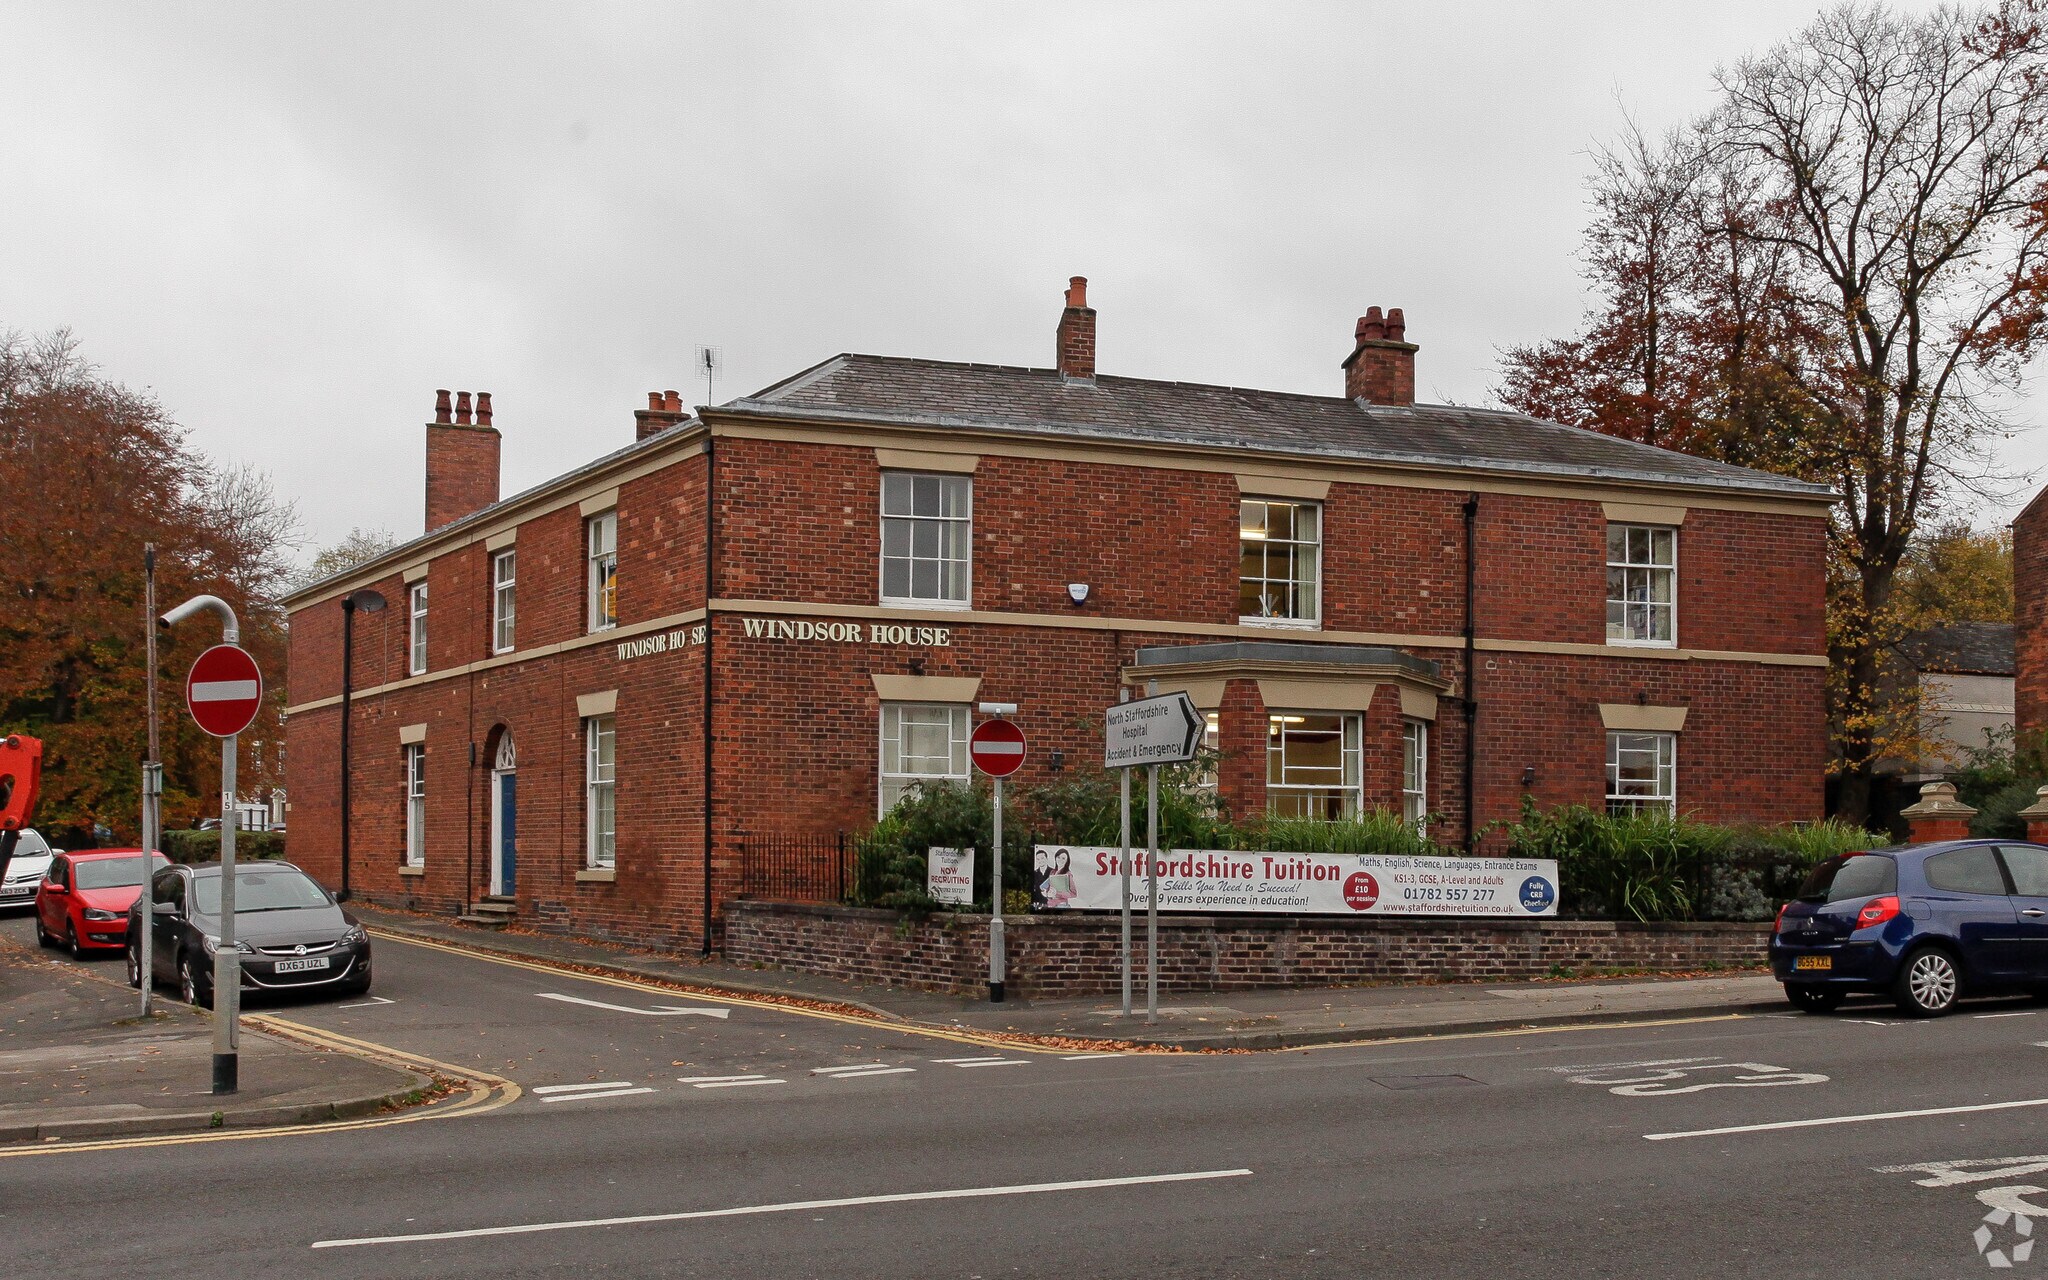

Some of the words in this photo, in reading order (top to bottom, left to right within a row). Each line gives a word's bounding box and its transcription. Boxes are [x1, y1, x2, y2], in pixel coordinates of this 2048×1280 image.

[743, 619, 862, 642] WINDSOR
[870, 624, 950, 647] HOUSE
[617, 634, 667, 660] WINDSOR
[1107, 713, 1124, 727] North
[1125, 704, 1169, 722] Staffordshire
[1122, 724, 1148, 739] Hospital
[1107, 746, 1132, 761] Accident
[1132, 745, 1137, 757] &
[1138, 743, 1182, 757] Emergency
[1262, 857, 1340, 881] Tuition
[1359, 857, 1383, 868] Maths,
[1385, 858, 1412, 870] English,
[1414, 858, 1442, 870] Science,
[1444, 860, 1482, 871] Languages,
[1485, 860, 1514, 870] Entrance
[1516, 861, 1538, 871] Exams
[940, 867, 958, 875] NOW
[931, 875, 970, 885] RECRUITING
[1354, 876, 1369, 884] From
[1394, 874, 1417, 885] KS1-3,
[1419, 874, 1439, 885] GCSE,
[1441, 875, 1467, 885] A-Level
[1468, 876, 1481, 885] and
[1483, 876, 1504, 885] Adults
[1163, 879, 1193, 891] Skills
[1195, 880, 1215, 894] You
[1217, 880, 1242, 892] Need
[1245, 884, 1254, 892] to
[1257, 882, 1302, 893] Succeed!
[1529, 882, 1544, 891] Fully
[1167, 895, 1193, 905] years
[1195, 895, 1247, 906] experience
[1249, 895, 1258, 905] in
[1260, 896, 1309, 906] education!
[1403, 887, 1442, 900] 01782
[1446, 889, 1468, 900] 557
[1472, 889, 1495, 901] 277
[1383, 903, 1514, 913] www.staffordshiretuition.co.uk
[1523, 899, 1549, 907] Checked
[279, 961, 305, 971] DX63
[307, 959, 325, 969] UZL
